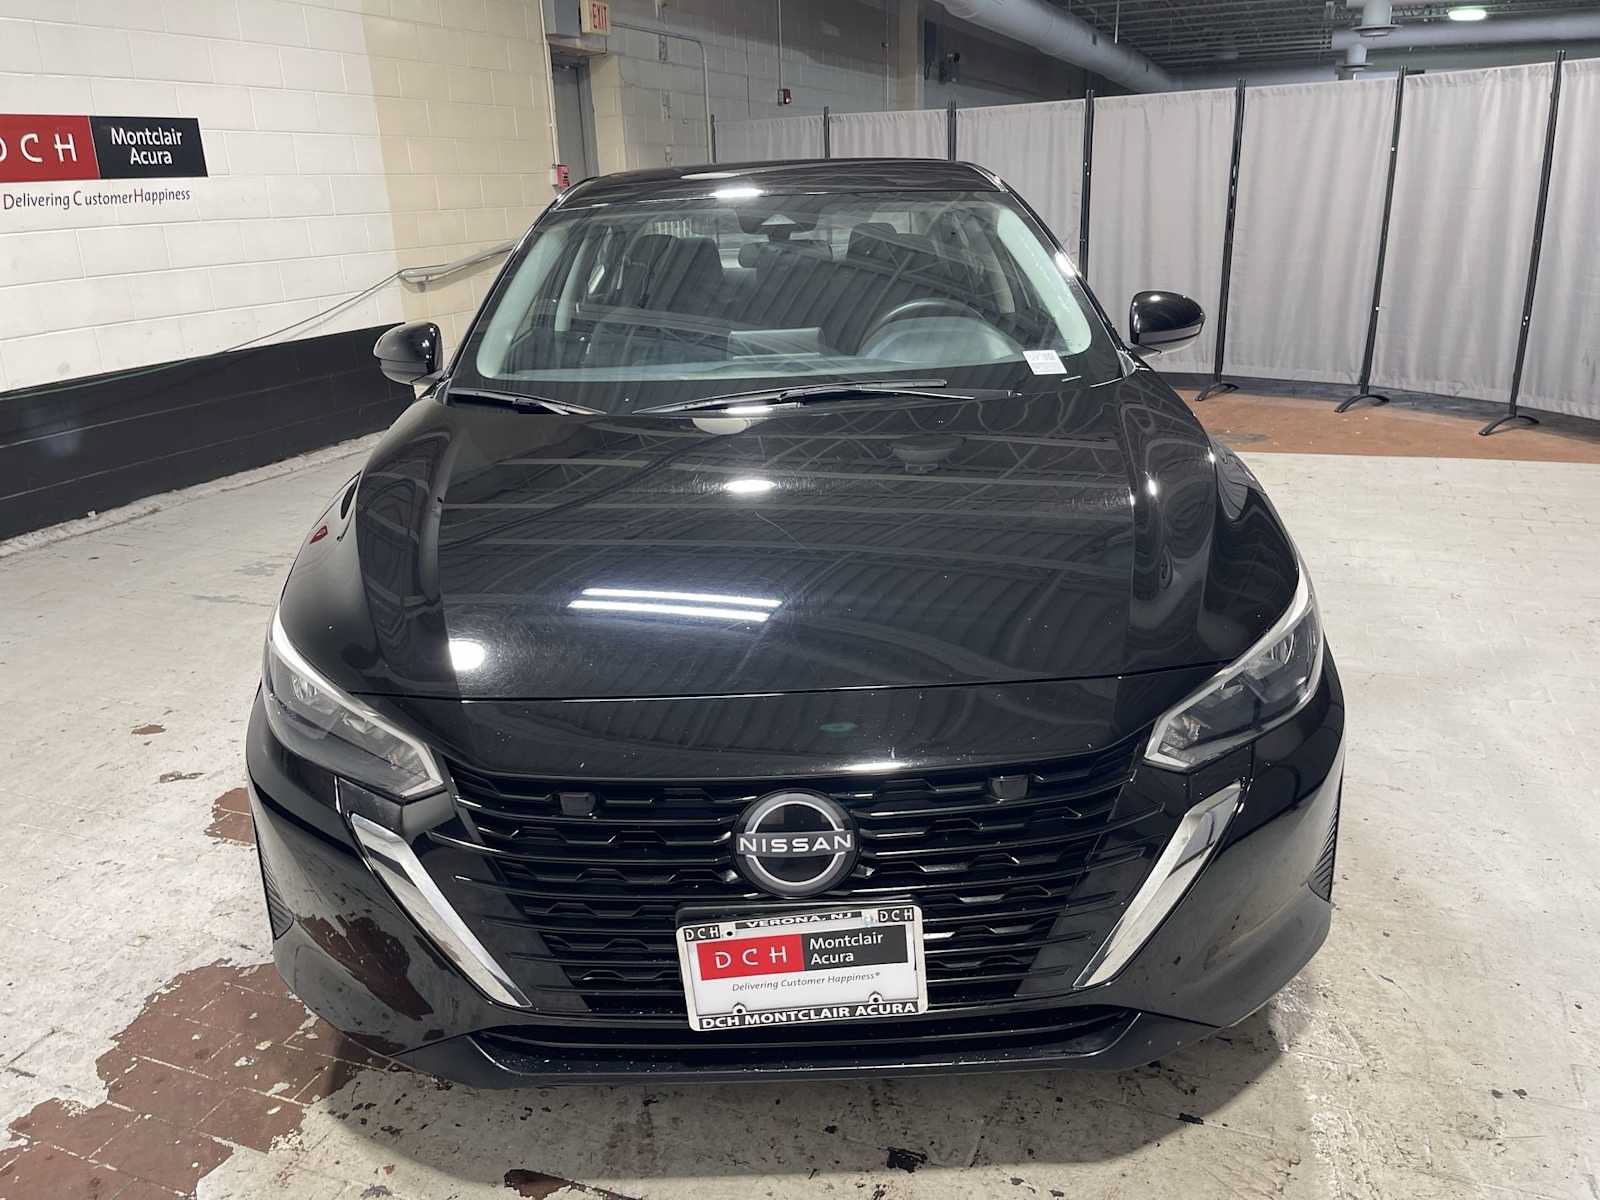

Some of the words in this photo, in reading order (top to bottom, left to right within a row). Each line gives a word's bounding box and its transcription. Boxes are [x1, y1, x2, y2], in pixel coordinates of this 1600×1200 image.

[592, 3, 607, 30] EXIT
[111, 127, 182, 146] Montclair
[130, 148, 173, 165] Acura
[3, 193, 70, 210] Delivering
[740, 834, 851, 852] NISSAN
[830, 912, 852, 920] NJ
[809, 932, 883, 950] Montclair
[810, 951, 854, 966] Acura
[732, 980, 778, 992] Delivering
[780, 977, 825, 988] Customer
[701, 1015, 740, 1029] DCH
[744, 1009, 849, 1026] MONTCLAIR
[855, 1002, 916, 1017] ACURA
